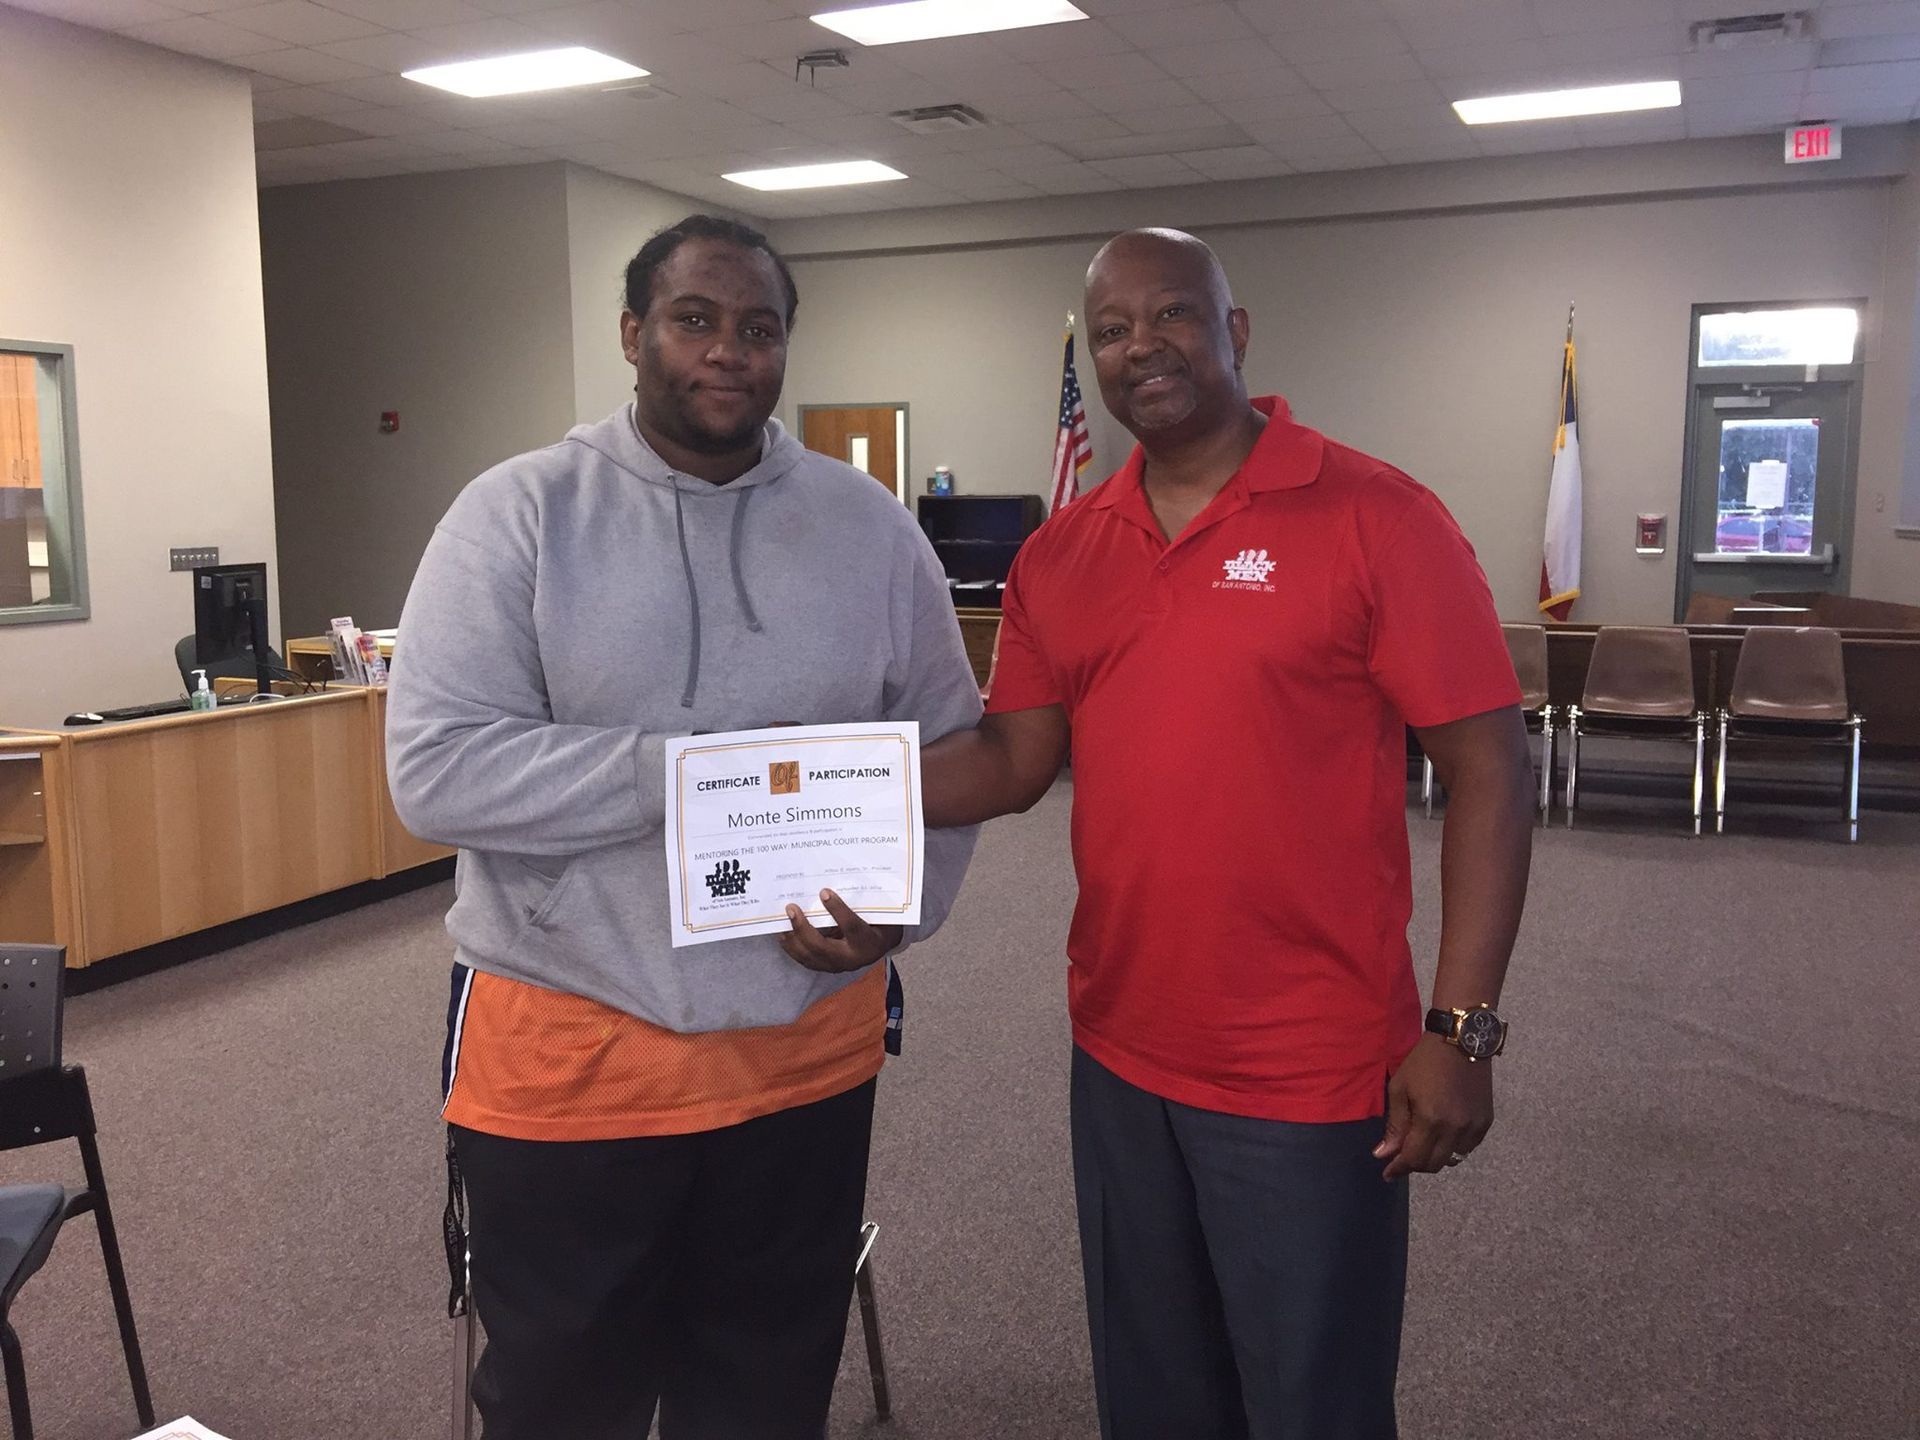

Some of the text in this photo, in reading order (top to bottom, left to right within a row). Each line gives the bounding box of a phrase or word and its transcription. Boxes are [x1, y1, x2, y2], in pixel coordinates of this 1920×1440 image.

[1794, 128, 1830, 158] EXIT
[1236, 549, 1268, 562] 100
[1211, 580, 1220, 588] OF
[697, 775, 761, 792] CERTIFICATE
[809, 767, 891, 782] PARTICIPATION
[728, 805, 862, 829] Monte Simmons
[694, 848, 739, 861] MENTORING
[741, 846, 754, 856] THE
[757, 845, 769, 853] 100
[791, 839, 832, 849] MUNICIPAL
[833, 837, 859, 846] COURT
[861, 836, 898, 845] PROGRAM
[715, 858, 740, 877] 100
[705, 869, 751, 887] BLACK
[711, 881, 746, 898] MEN
